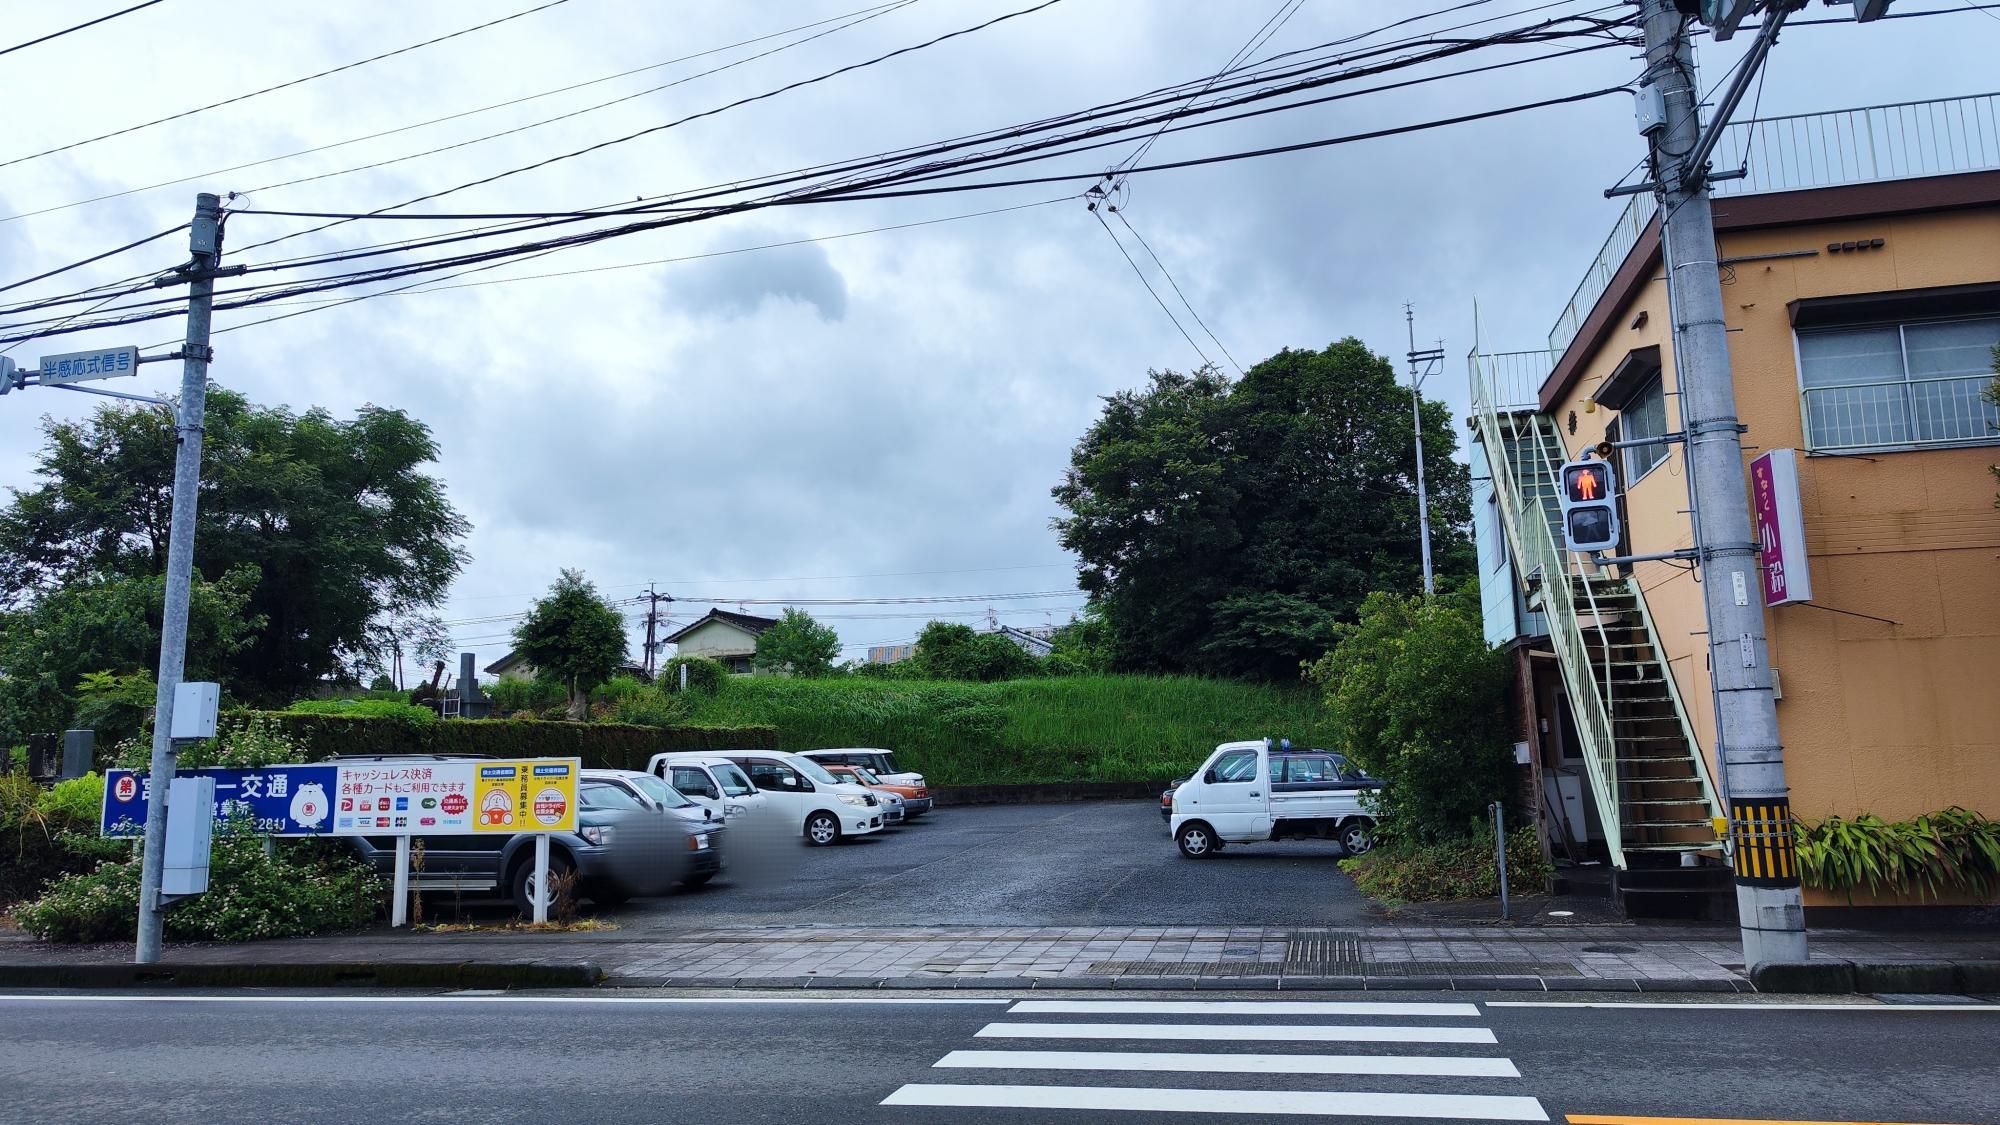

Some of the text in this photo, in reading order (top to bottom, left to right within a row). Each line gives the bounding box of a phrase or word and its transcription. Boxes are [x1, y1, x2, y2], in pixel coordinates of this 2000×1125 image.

[43, 352, 130, 379] 半感応式信号
[1756, 467, 1770, 511] すなっく
[342, 768, 432, 781] キャッシュレス決済
[342, 782, 466, 795] 各種カードもご利用できます
